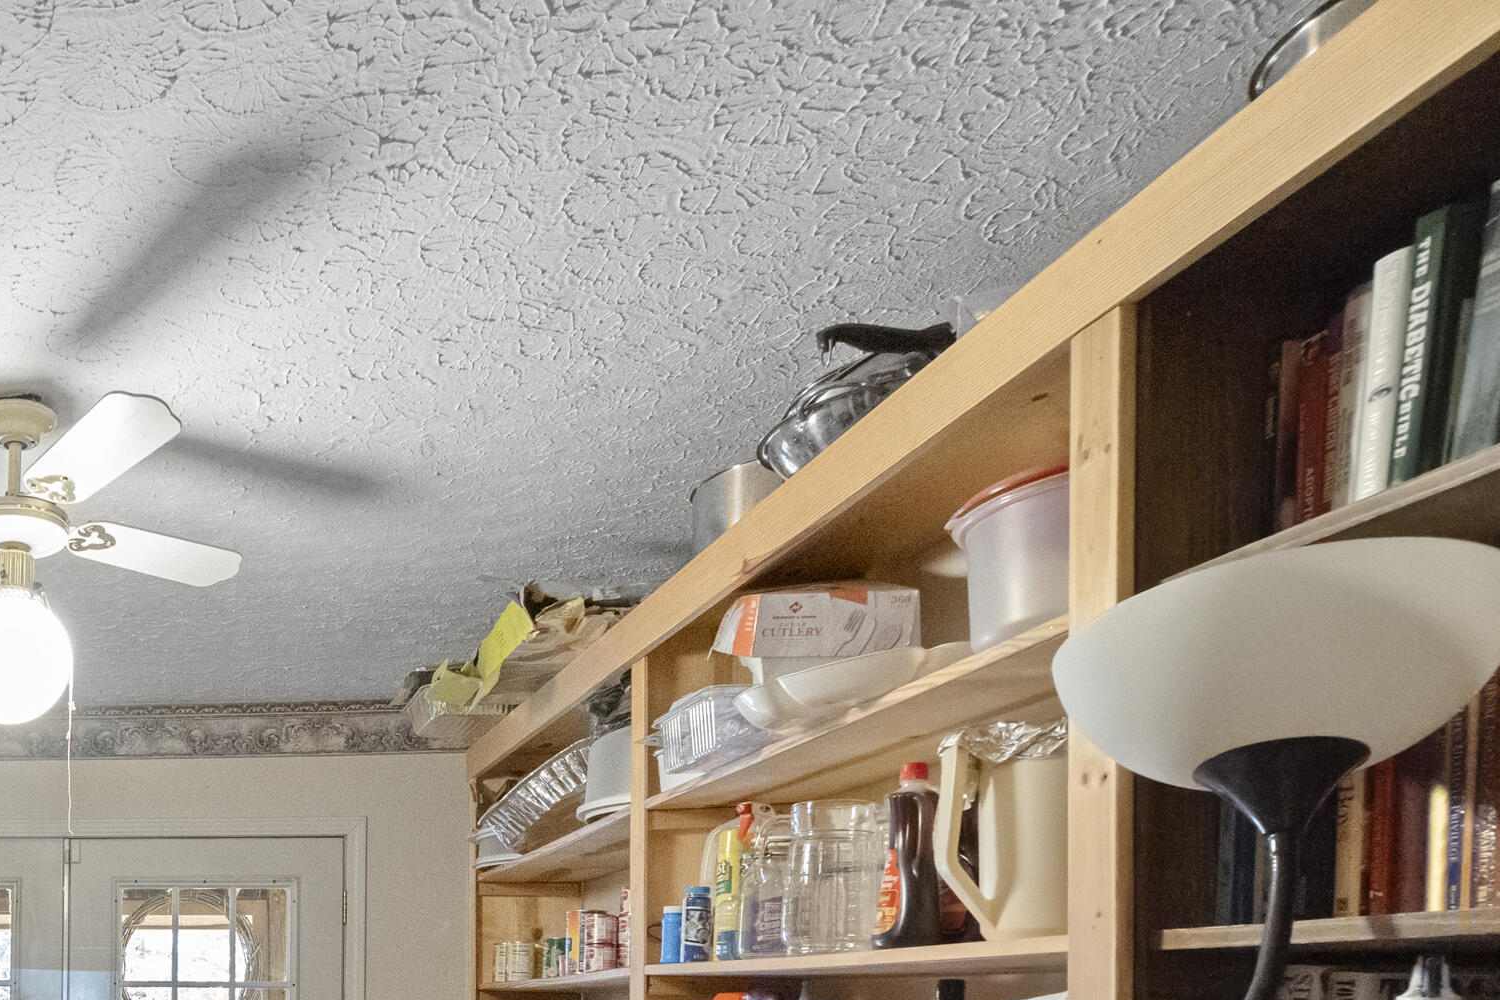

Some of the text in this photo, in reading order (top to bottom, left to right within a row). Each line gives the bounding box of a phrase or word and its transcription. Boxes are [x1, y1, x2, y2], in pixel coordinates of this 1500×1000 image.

[1393, 235, 1432, 459] THE DIABETIC BIBLE
[762, 626, 823, 637] CUTLERY
